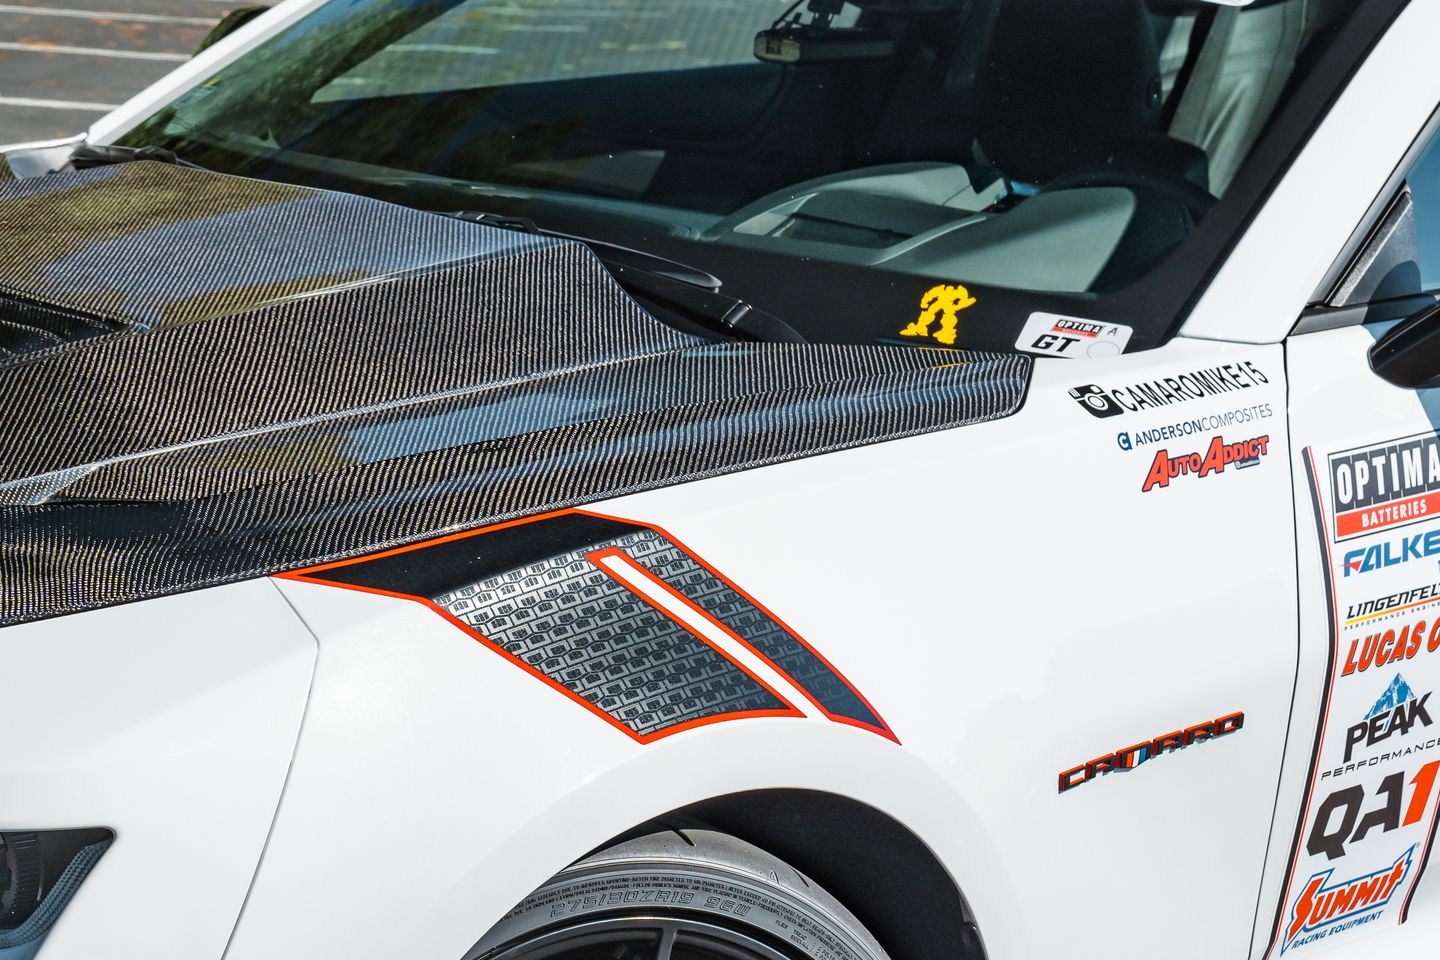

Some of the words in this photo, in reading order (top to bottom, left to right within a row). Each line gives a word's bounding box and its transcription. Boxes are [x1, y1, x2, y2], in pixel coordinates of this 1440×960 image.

[1031, 334, 1081, 352] GT
[1057, 320, 1101, 333] OPTIMA
[1111, 361, 1269, 412] CAMAROMIKE15
[1336, 442, 1440, 505] OPTIMA
[1361, 499, 1428, 528] BATTERIES
[1346, 582, 1440, 619] LINGENFEL
[1340, 620, 1427, 677] LUCAS
[1058, 711, 1245, 794] CAMARO
[1343, 690, 1434, 764] PEAK
[1306, 760, 1440, 861] QA1
[1291, 930, 1328, 950] RACING
[1328, 909, 1385, 937] EQUIPMENT
